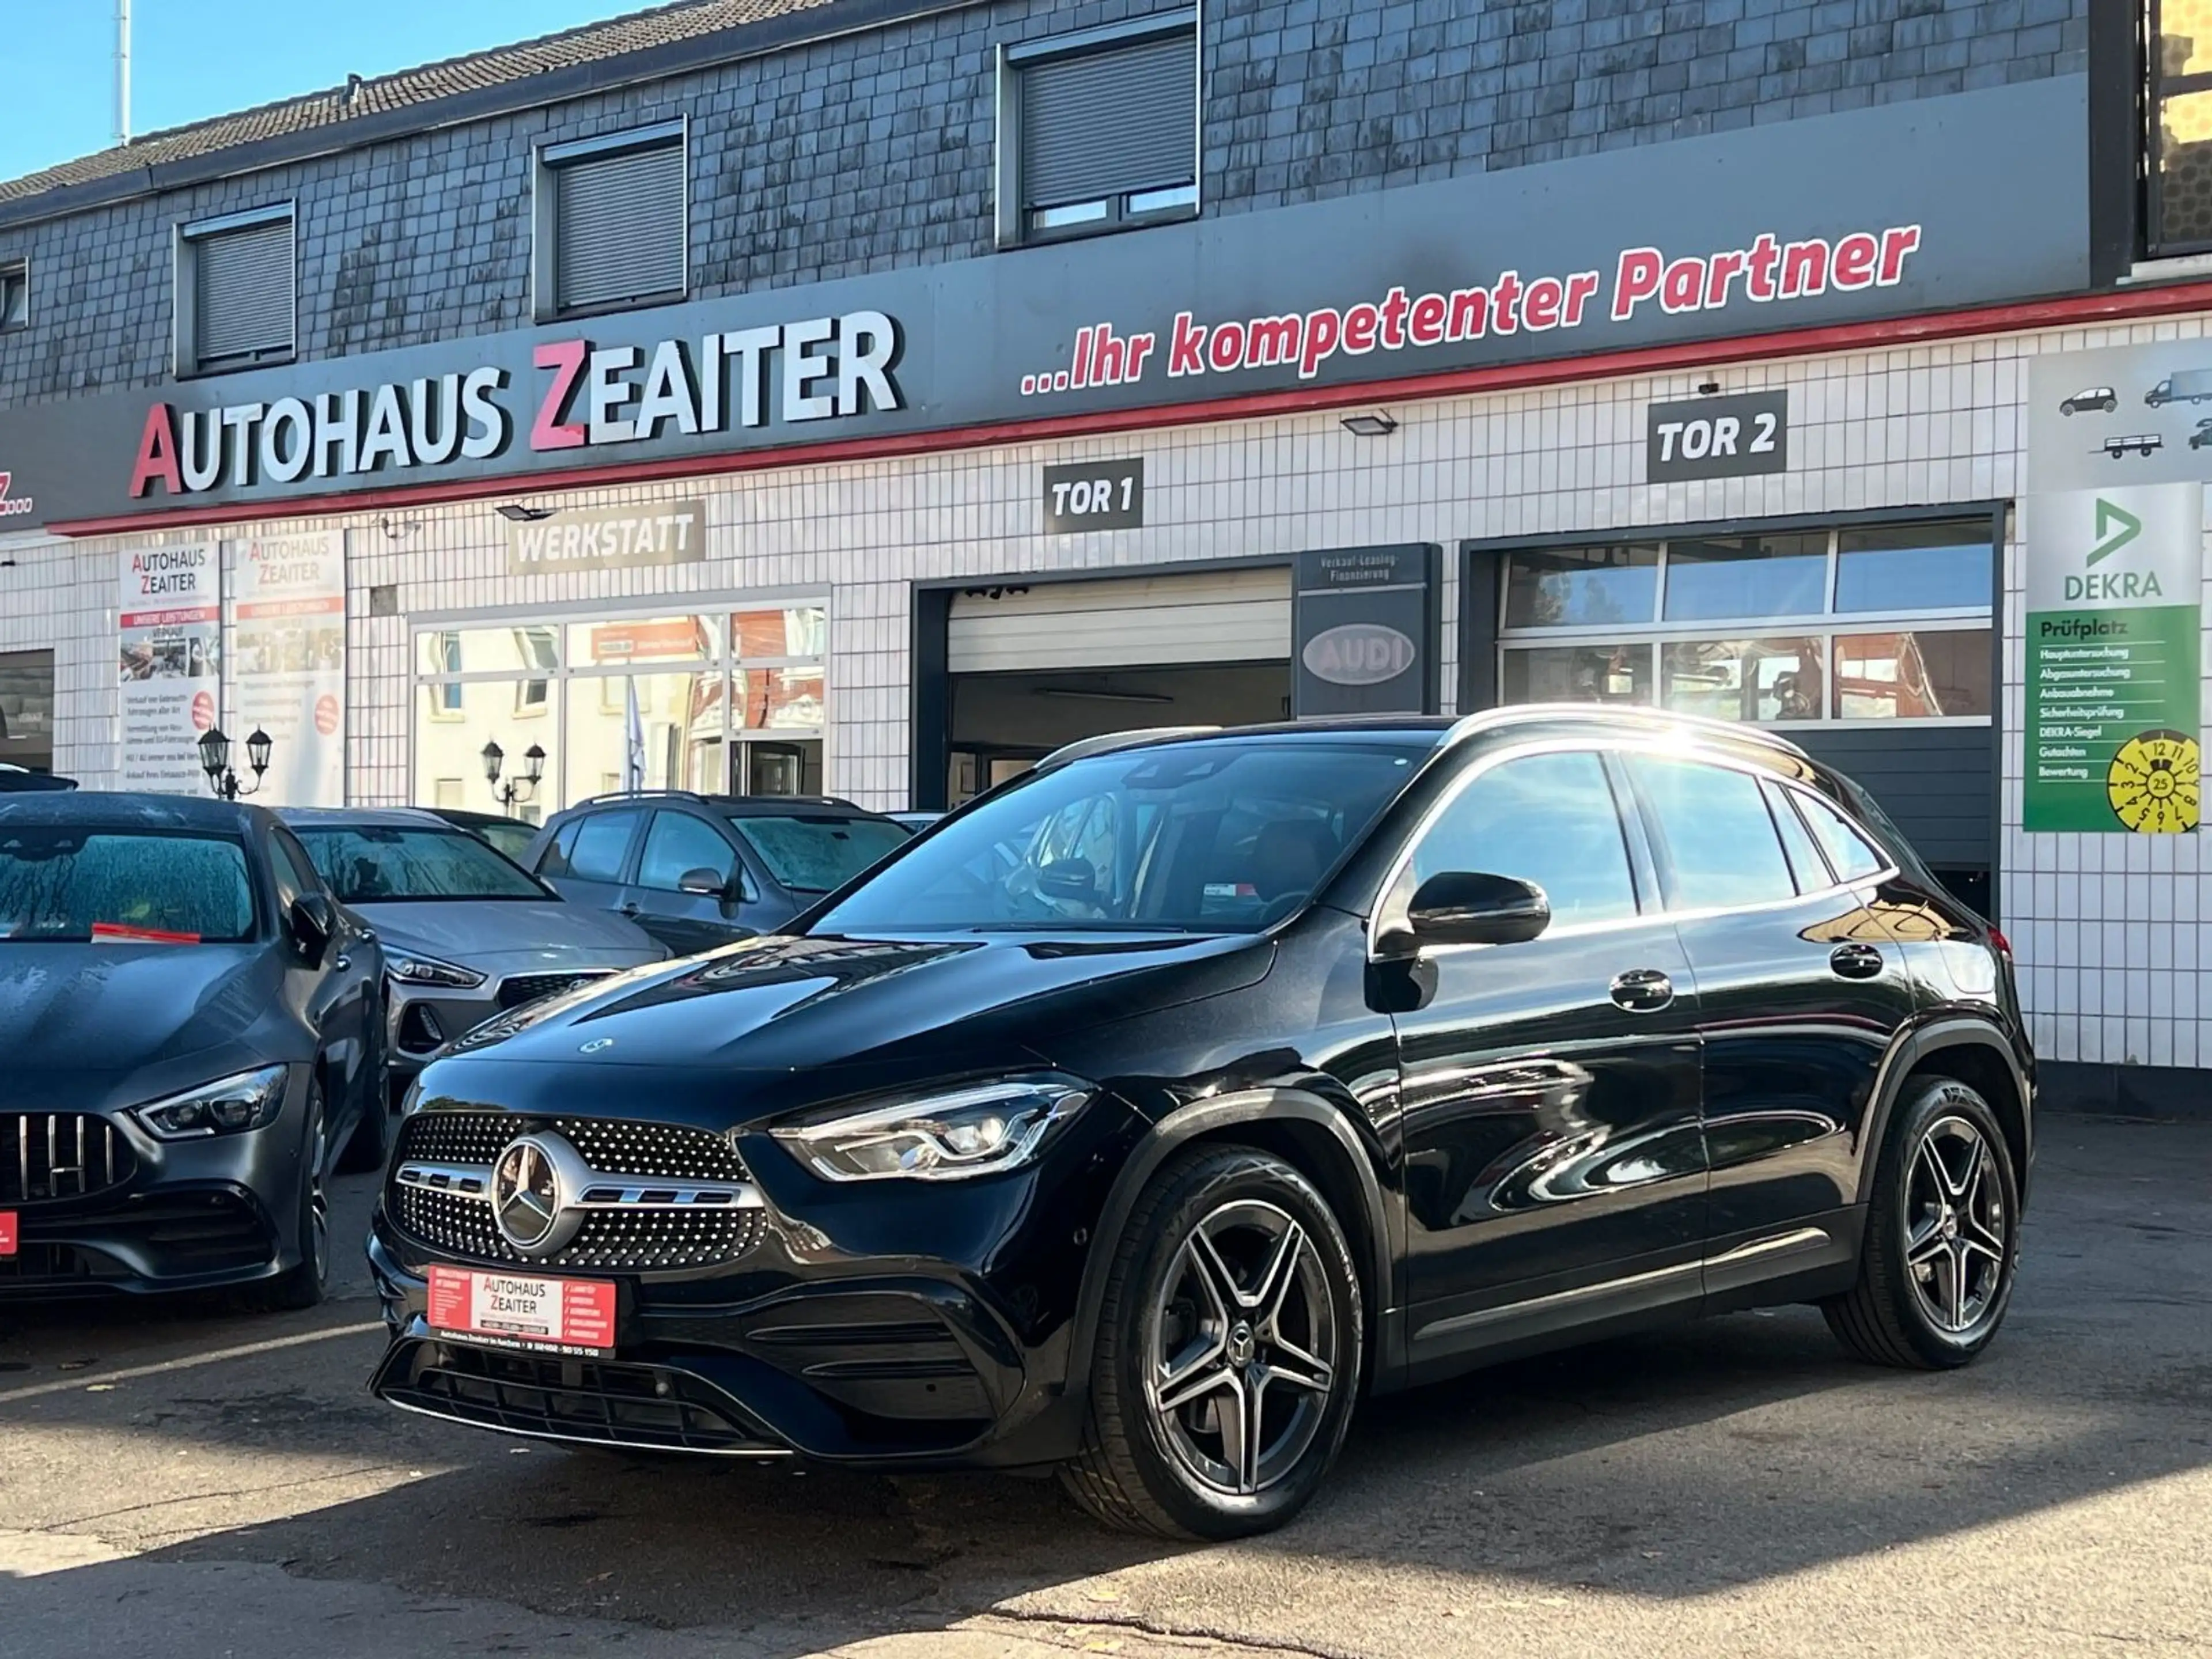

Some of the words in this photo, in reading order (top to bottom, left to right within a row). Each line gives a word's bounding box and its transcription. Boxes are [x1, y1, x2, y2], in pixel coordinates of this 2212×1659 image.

[1167, 270, 1599, 380] kompetenter
[1611, 225, 1922, 321] Partner
[128, 366, 508, 498] AUTOHAUS
[529, 310, 904, 451] ZEAITER
[1656, 418, 1740, 461] TOR
[1749, 412, 1777, 454] 2
[1052, 480, 1112, 516] TOR
[1120, 477, 1132, 512] 1
[518, 513, 694, 563] WERKSTATT
[249, 536, 329, 562] AUTOHAUS
[132, 548, 206, 573] AUTOHAUS
[141, 573, 196, 595] ZEAITER
[258, 562, 320, 586] ZEAITER
[2065, 571, 2163, 601] DEKRA
[2040, 618, 2128, 641] Prüfplatz
[1319, 637, 1403, 671] AUDI
[2040, 646, 2129, 661] Hauptuntersuchung
[2039, 725, 2102, 739] DEKRA-Siegel
[2139, 749, 2149, 762] 1
[2153, 743, 2166, 756] 12
[2172, 745, 2184, 761] 11
[2039, 766, 2089, 779] Bewertung
[2125, 762, 2139, 774] 2
[2183, 757, 2199, 774] 10
[2153, 778, 2169, 790] 25
[2183, 795, 2197, 806] 8
[2138, 808, 2151, 821] 5
[2175, 806, 2183, 820] 7
[484, 1276, 546, 1298] AUTOHAUS
[490, 1294, 537, 1313] ZEAITER
